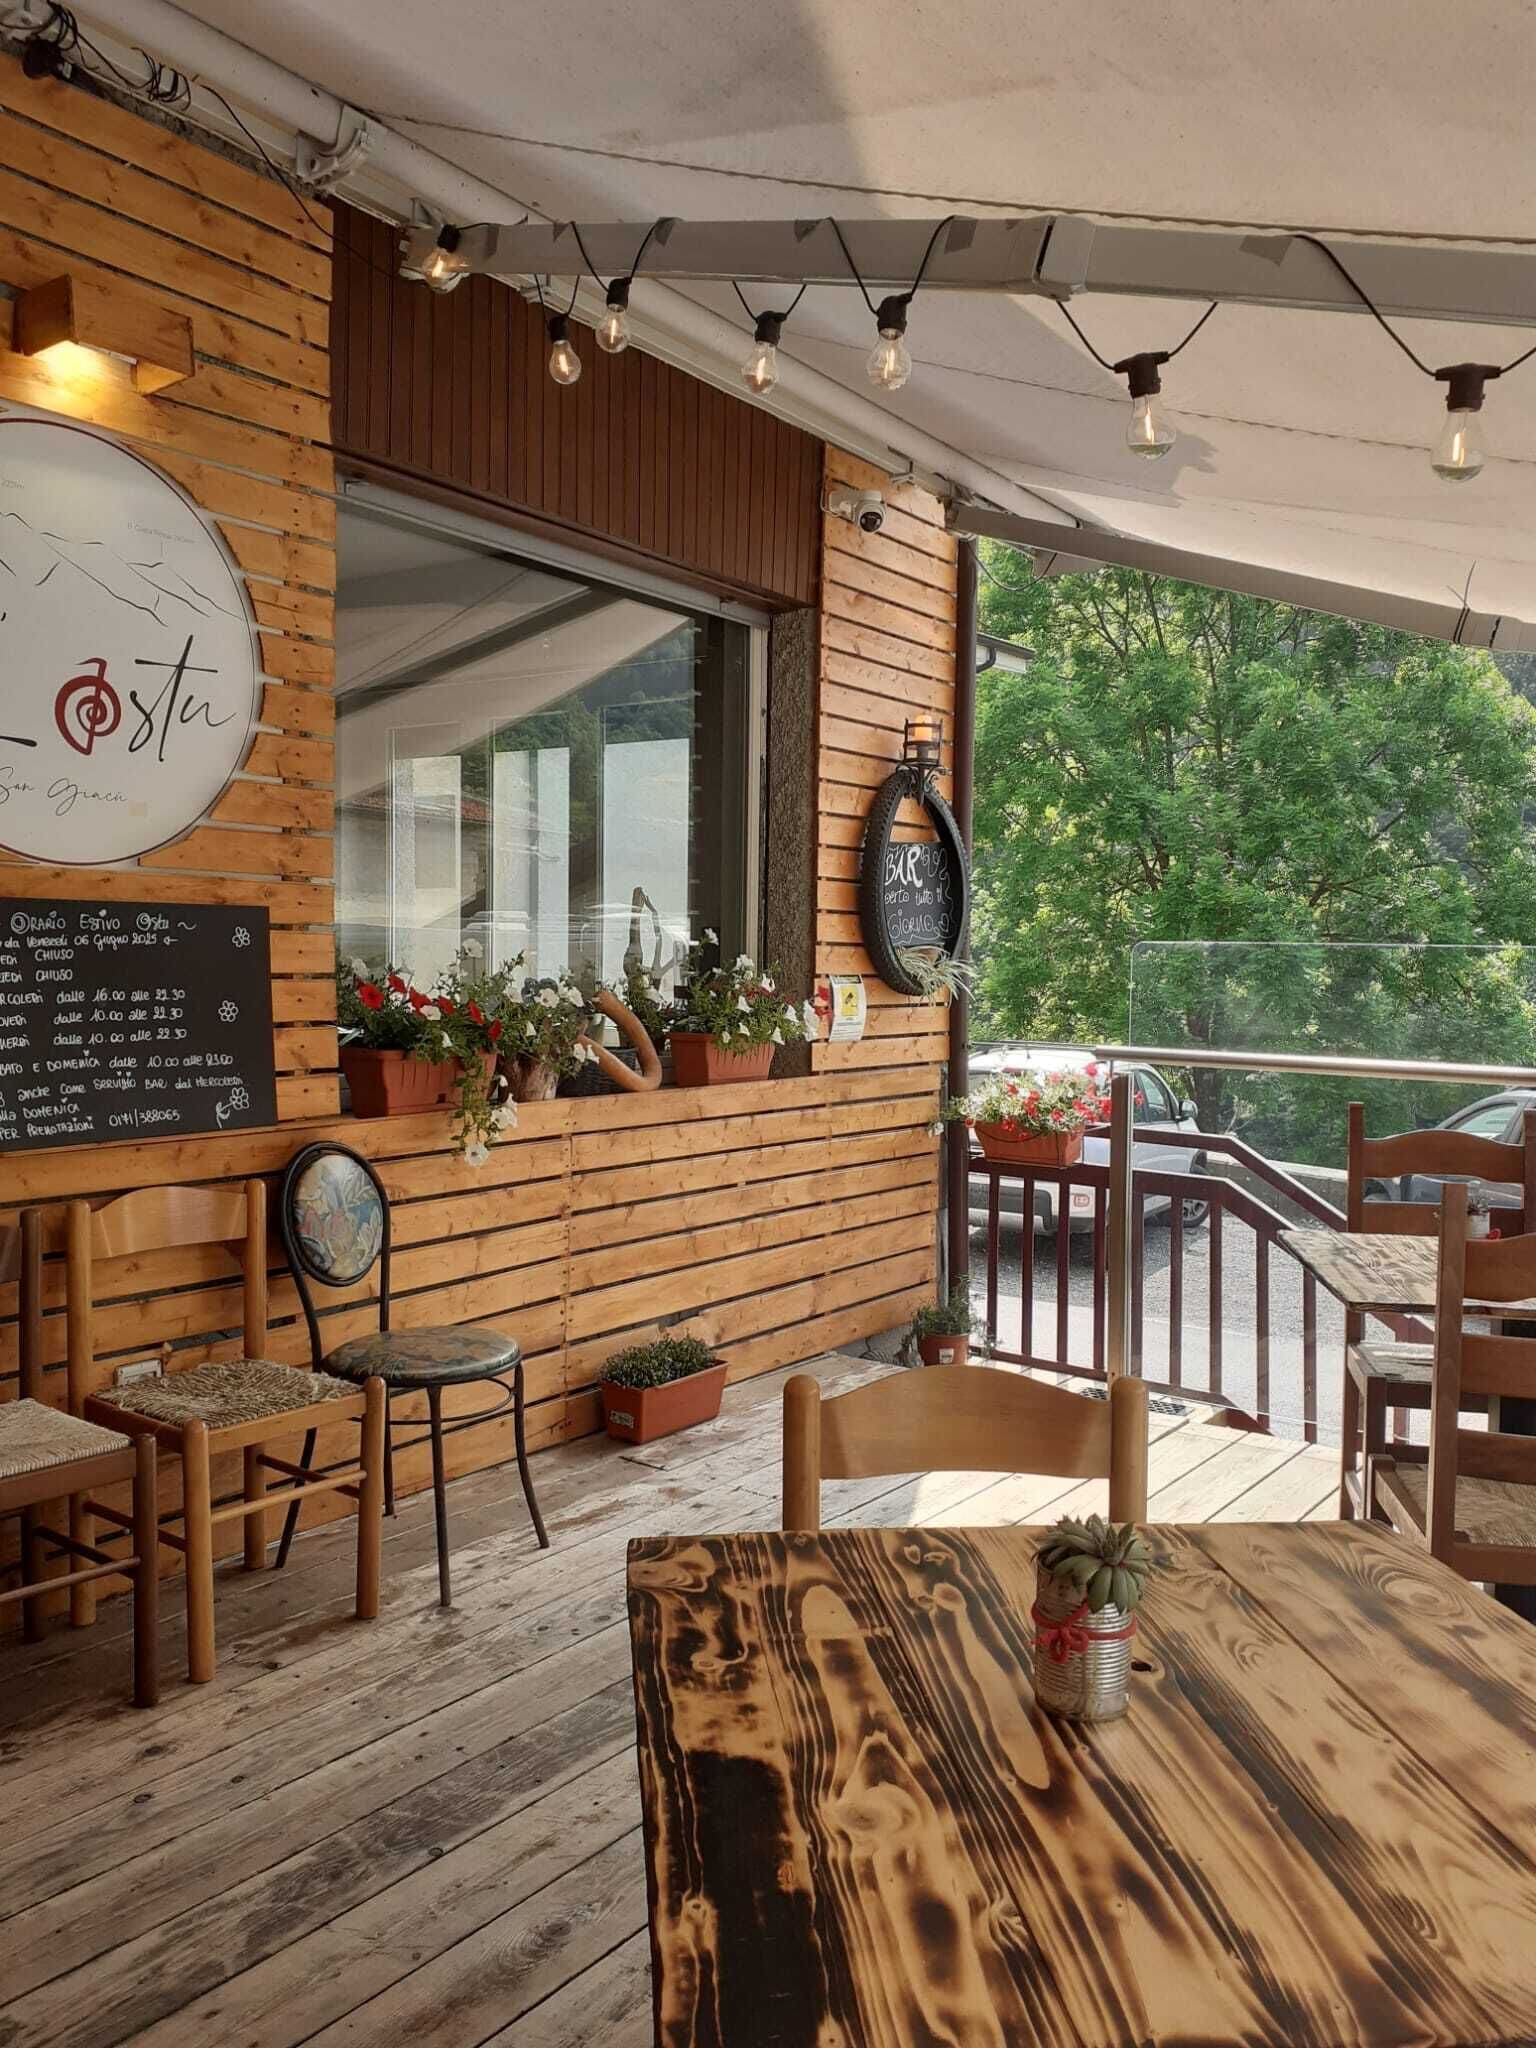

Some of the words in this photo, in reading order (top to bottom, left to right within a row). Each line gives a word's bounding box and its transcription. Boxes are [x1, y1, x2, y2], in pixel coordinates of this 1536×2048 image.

[885, 846, 923, 888] BAR
[74, 935, 89, 946] 06
[132, 932, 157, 945] 2025
[35, 949, 74, 961] CHIUSO
[36, 968, 73, 982] CHIUSO
[57, 990, 85, 1004] dalle
[92, 988, 125, 1002] 16.00
[131, 990, 150, 1002] alle
[53, 1011, 83, 1025] dalle
[89, 1008, 123, 1022] 10.00
[128, 1008, 149, 1021] alle
[53, 1033, 83, 1046] dalle
[130, 1029, 152, 1042] alle
[33, 1062, 40, 1073] E
[109, 1056, 138, 1069] dalle
[182, 1055, 203, 1067] alle
[17, 1086, 51, 1102] anche
[175, 1077, 192, 1089] dal
